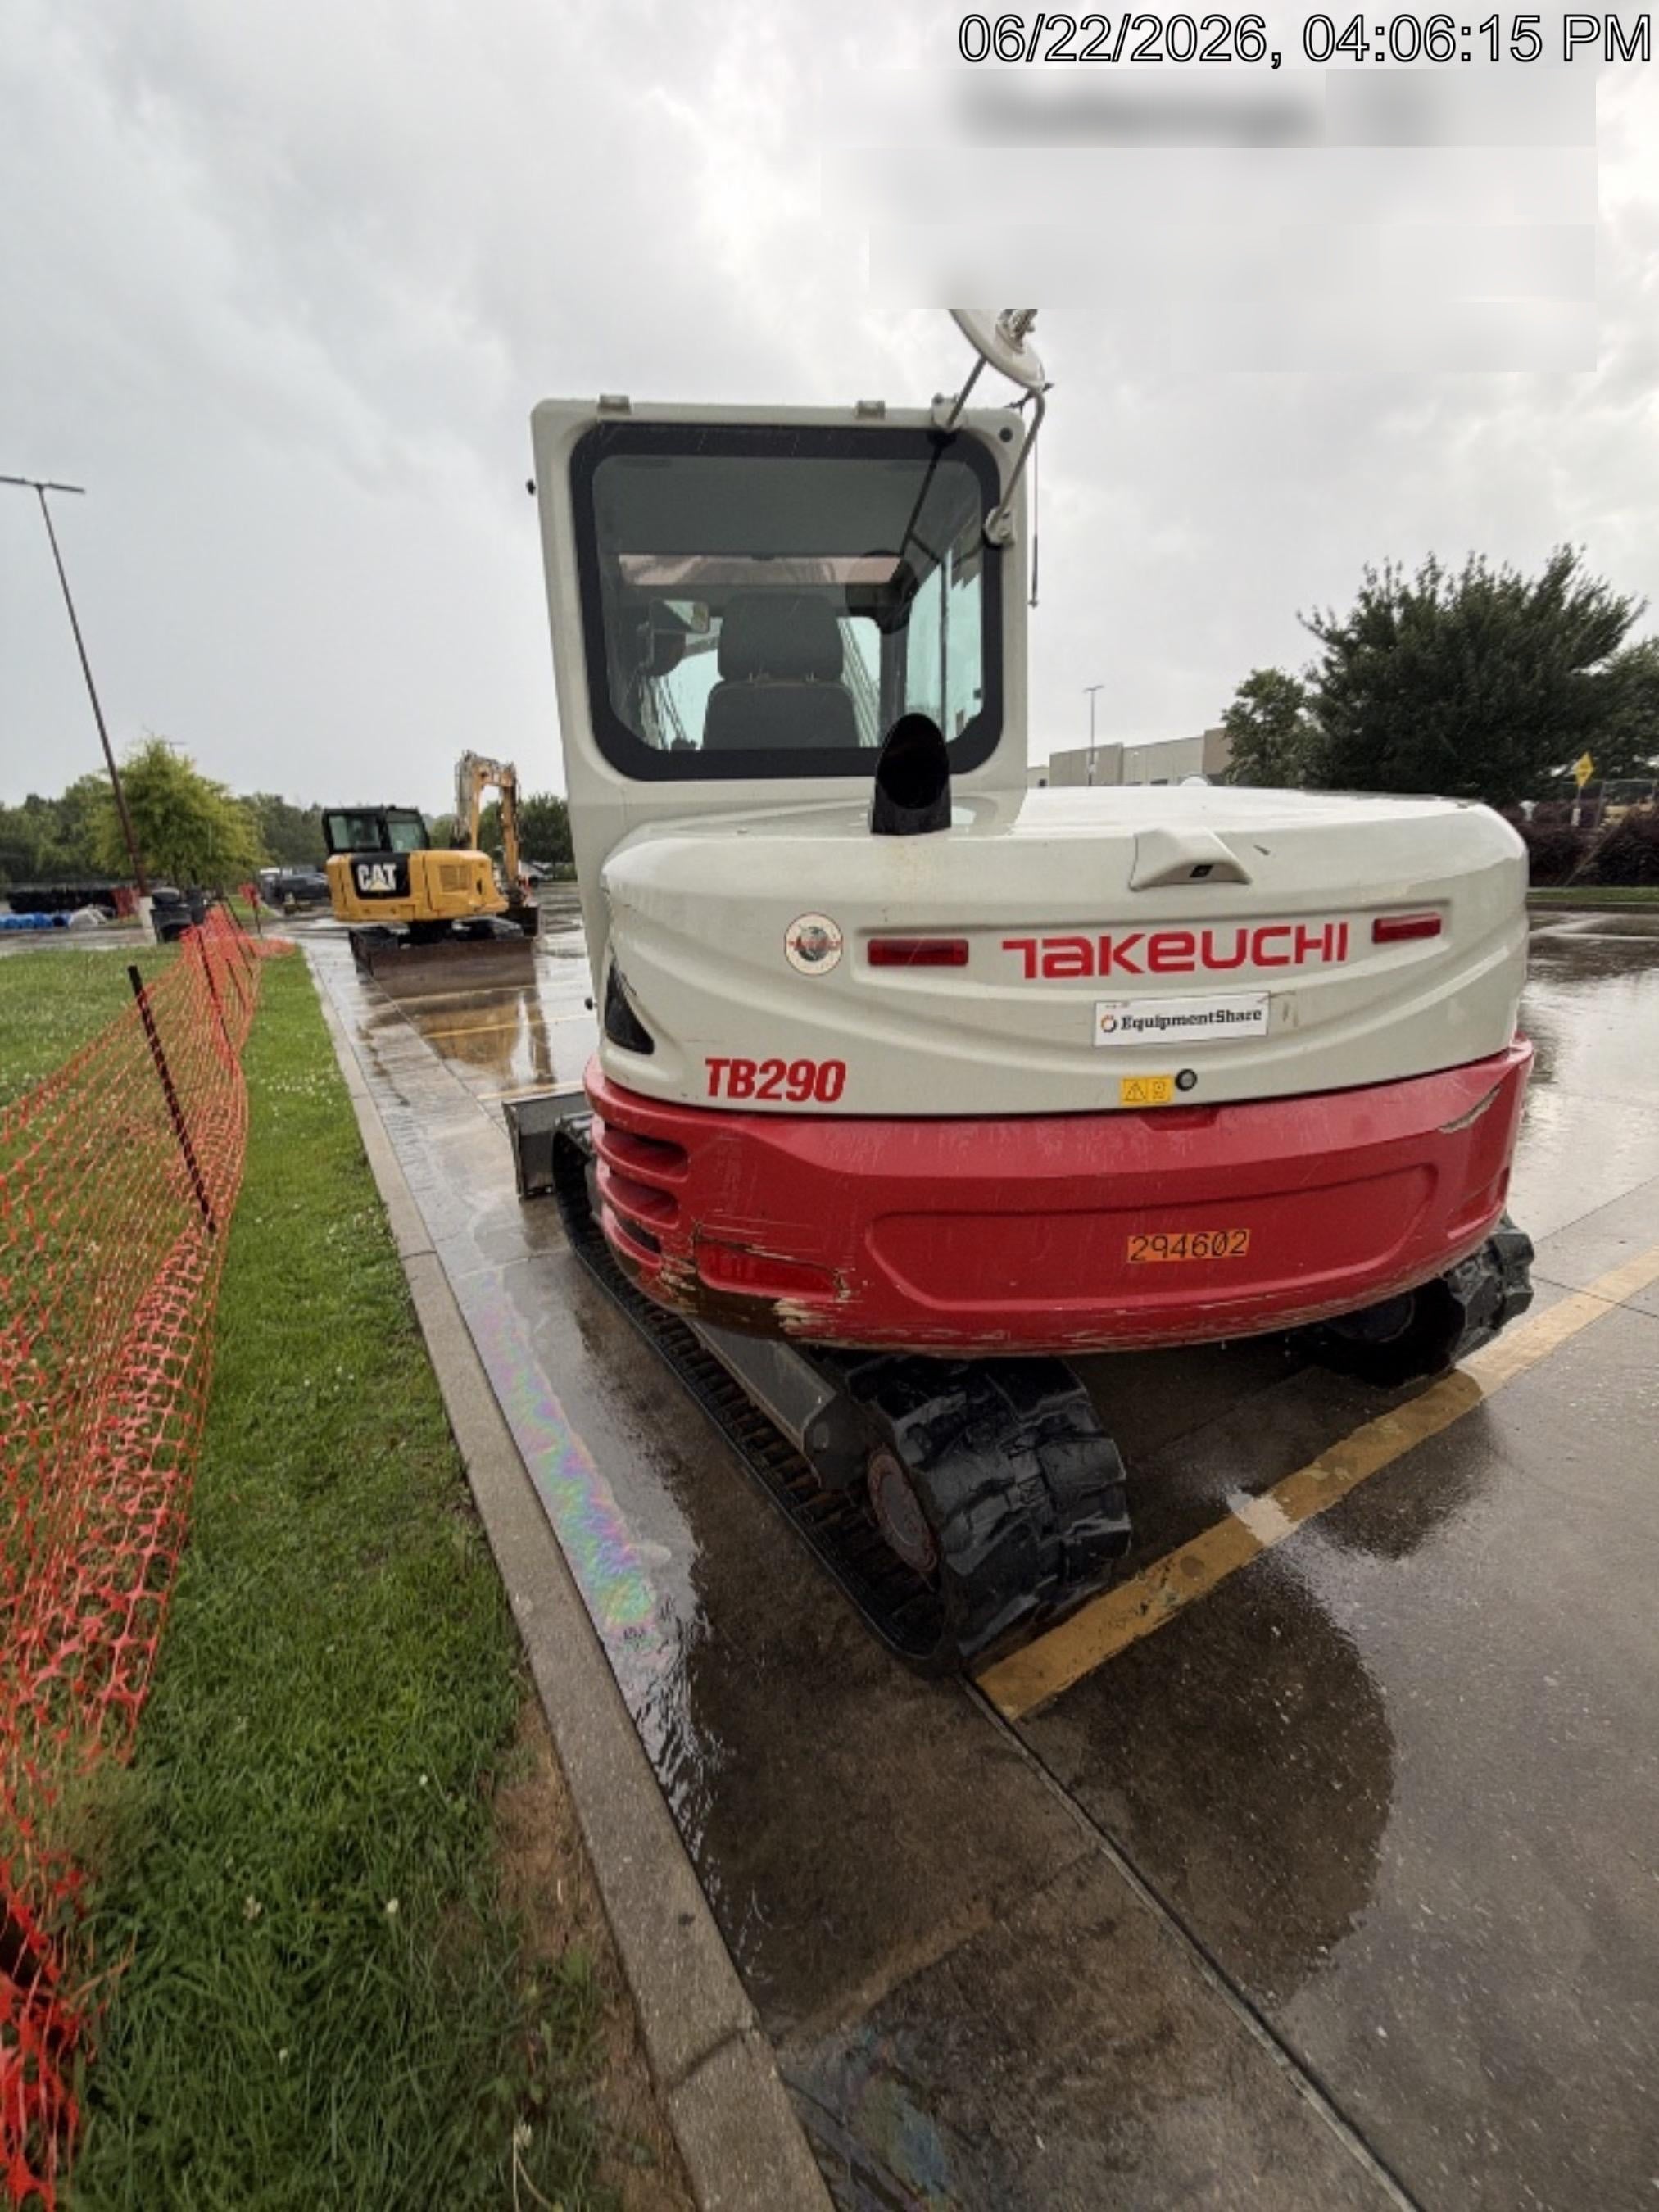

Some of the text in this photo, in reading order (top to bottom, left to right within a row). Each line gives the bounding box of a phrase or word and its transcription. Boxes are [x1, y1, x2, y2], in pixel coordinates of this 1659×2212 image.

[358, 863, 397, 891] CAT
[1120, 1009, 1262, 1031] EquipmentShare
[705, 1058, 846, 1103] TB290
[1130, 1230, 1248, 1262] 294602
